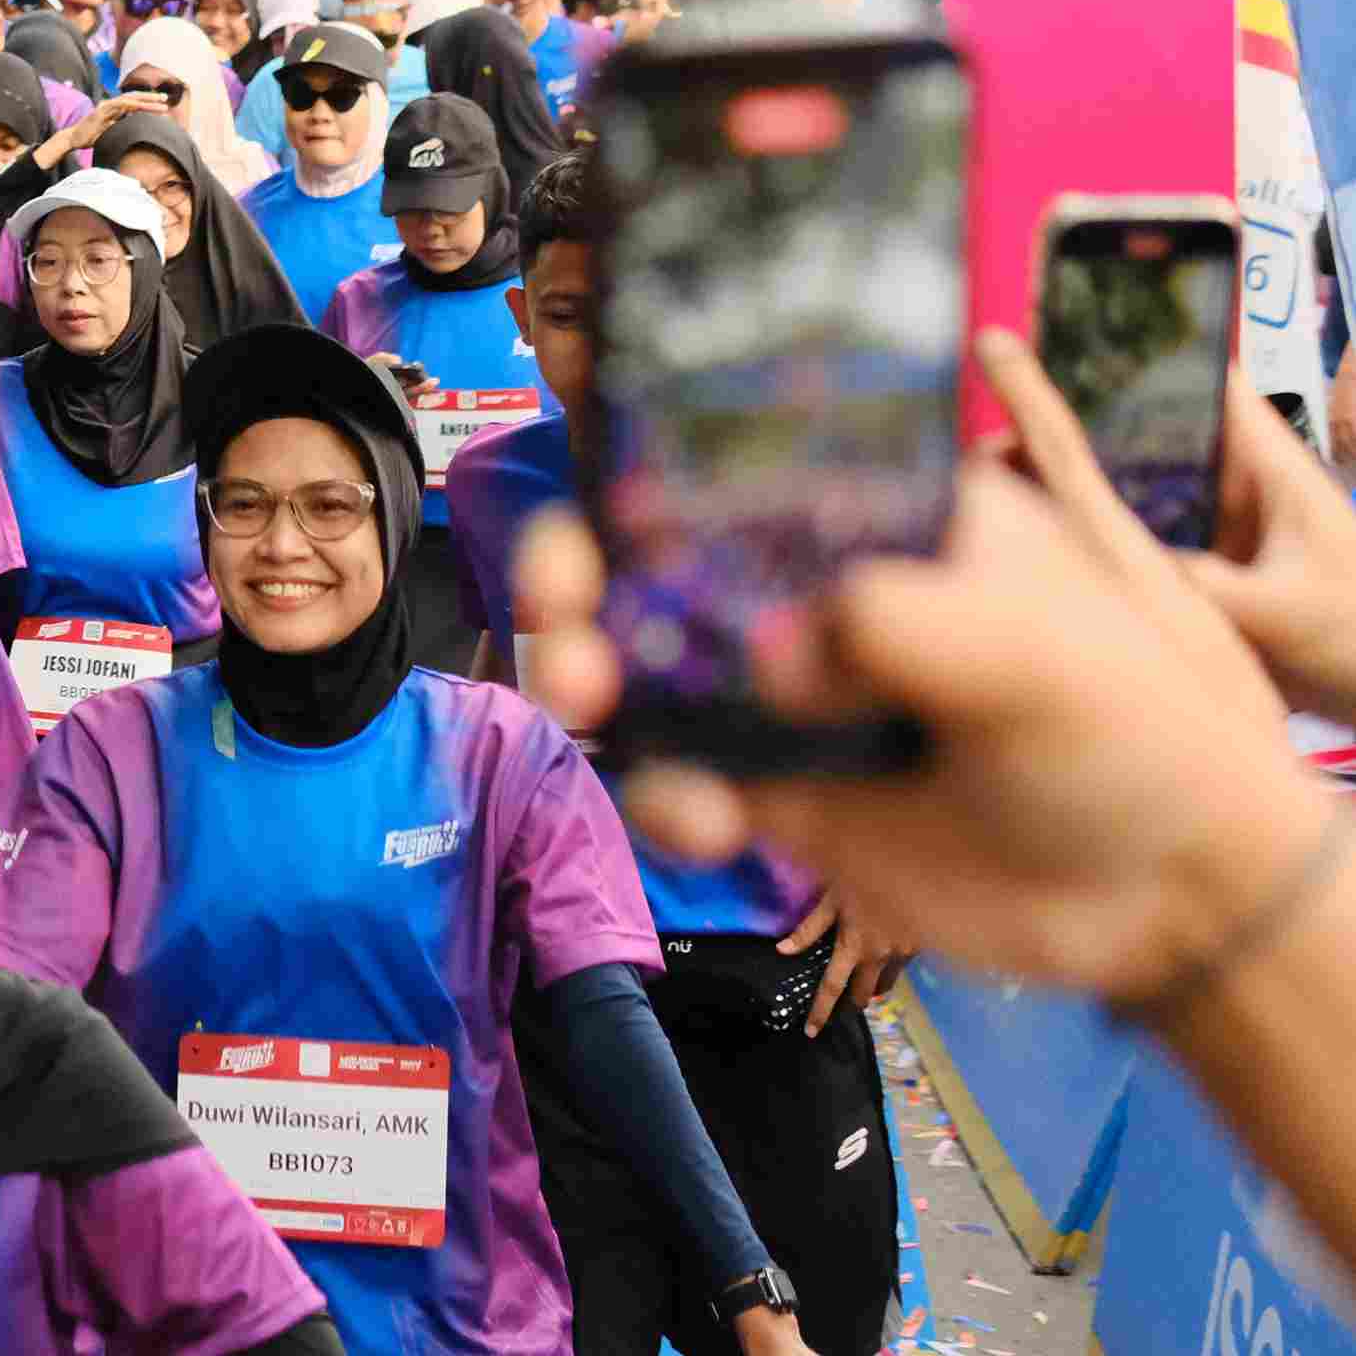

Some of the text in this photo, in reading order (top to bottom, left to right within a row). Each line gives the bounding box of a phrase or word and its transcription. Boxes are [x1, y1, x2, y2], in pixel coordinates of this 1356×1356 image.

[42, 654, 136, 680] JESSI JOFANI
[187, 1100, 430, 1136] Duwi Wilansari, AMK
[268, 1151, 354, 1175] BB1073
